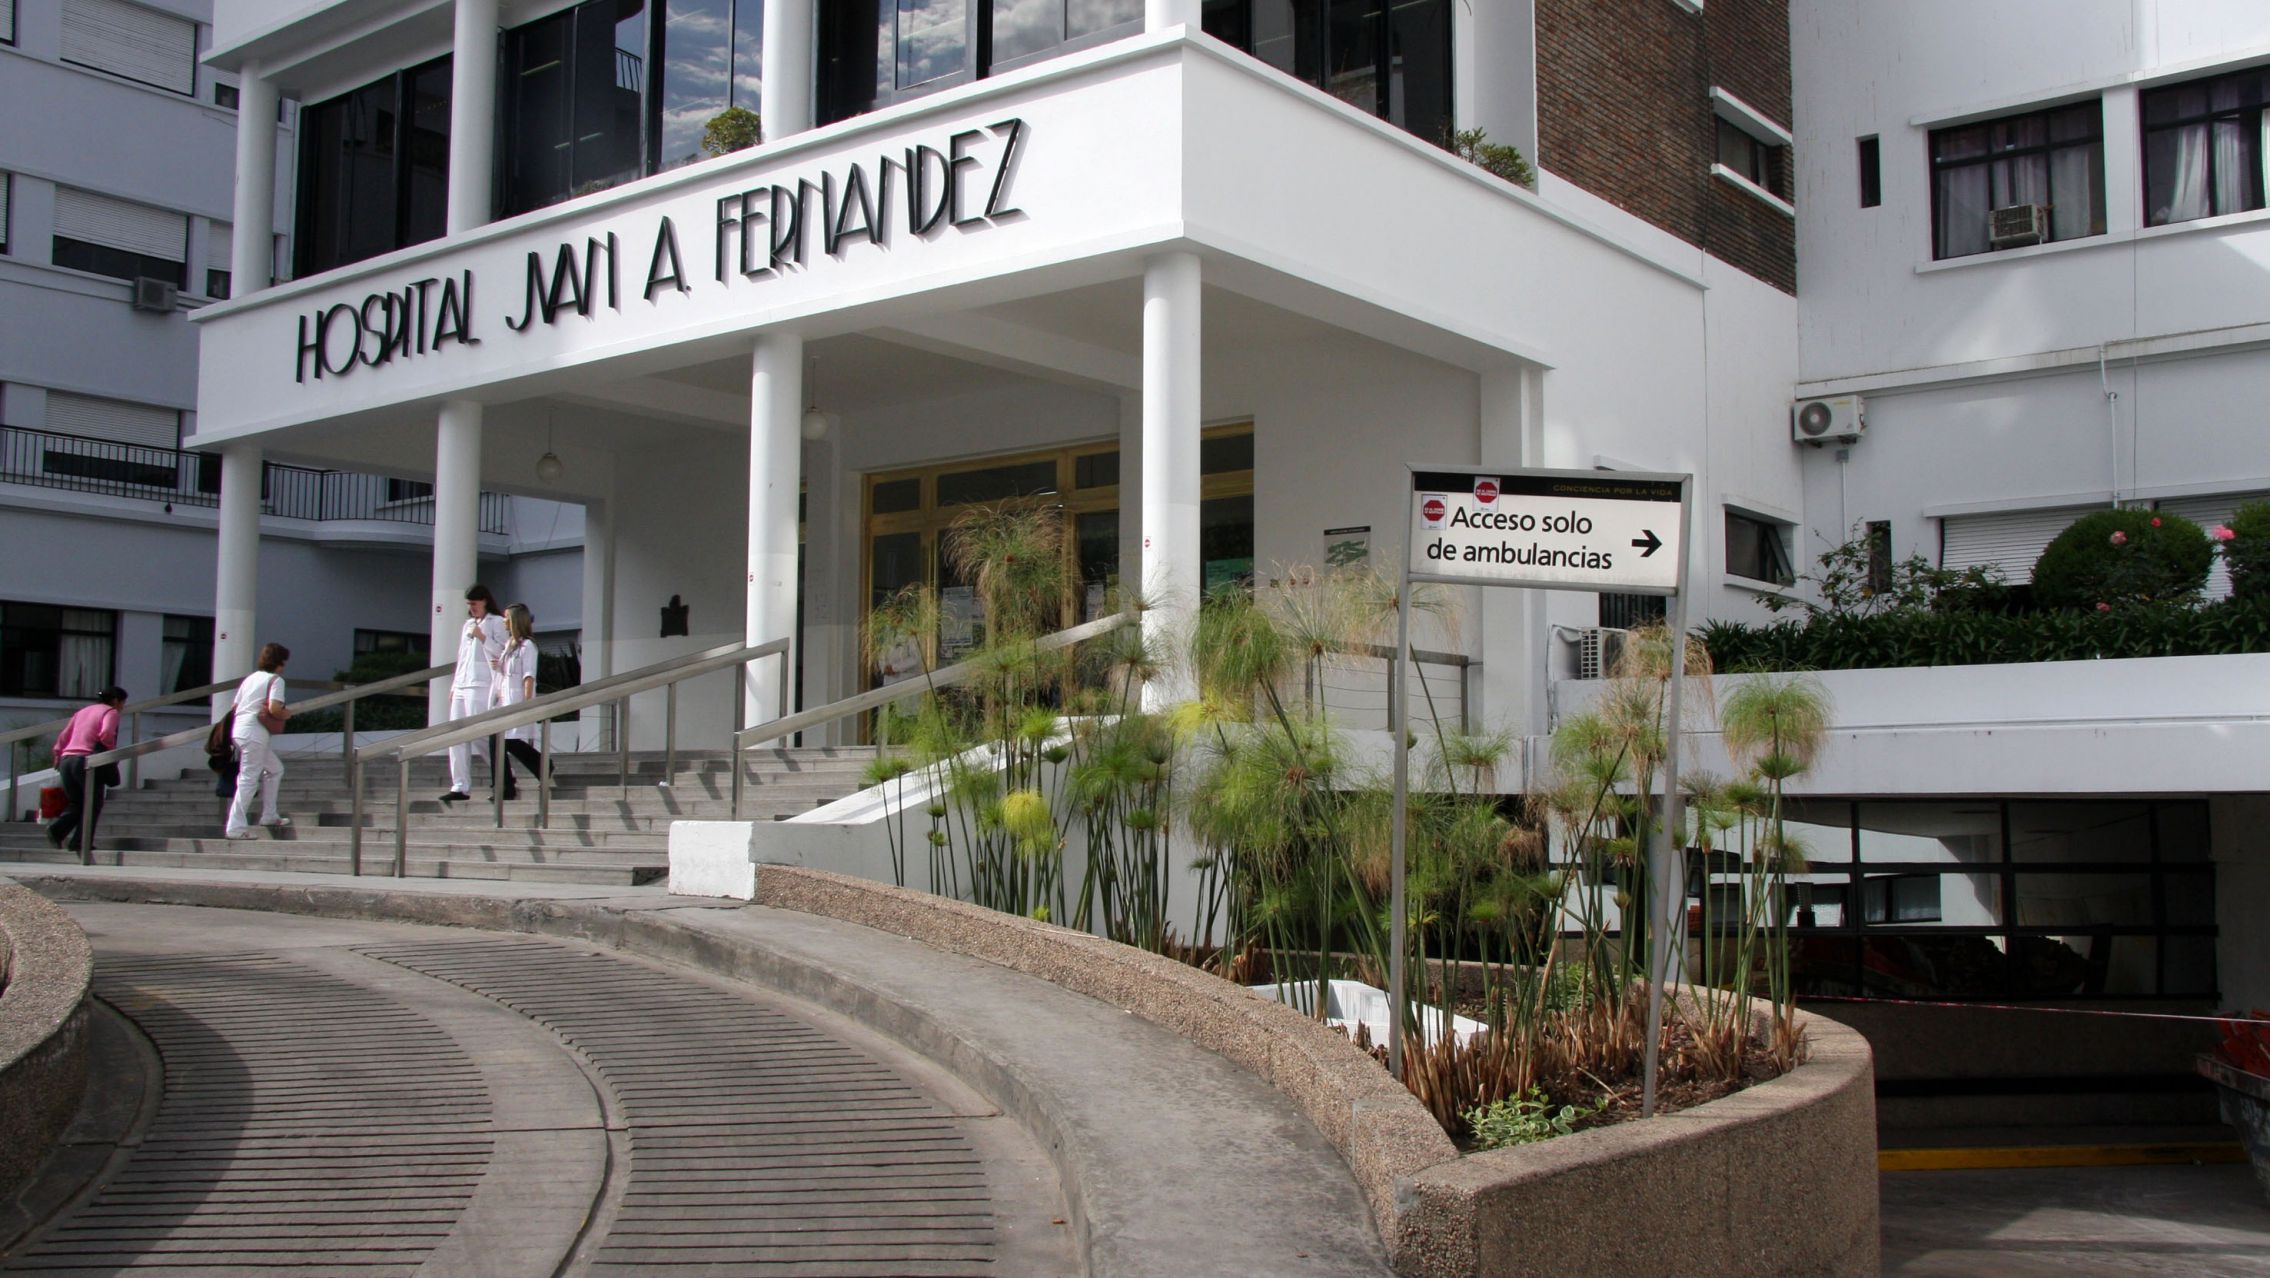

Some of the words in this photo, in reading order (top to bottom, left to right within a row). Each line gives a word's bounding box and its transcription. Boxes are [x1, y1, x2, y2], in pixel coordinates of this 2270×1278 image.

[296, 269, 481, 384] HOSPITAL
[716, 118, 1021, 282] FERNANDEZ
[1553, 484, 1610, 494] CONCIENCIA
[1614, 487, 1632, 495] POR
[1450, 506, 1536, 532] Acceso
[1542, 510, 1593, 534] solo
[1427, 537, 1457, 560] de
[1463, 541, 1612, 569] ambulancias
